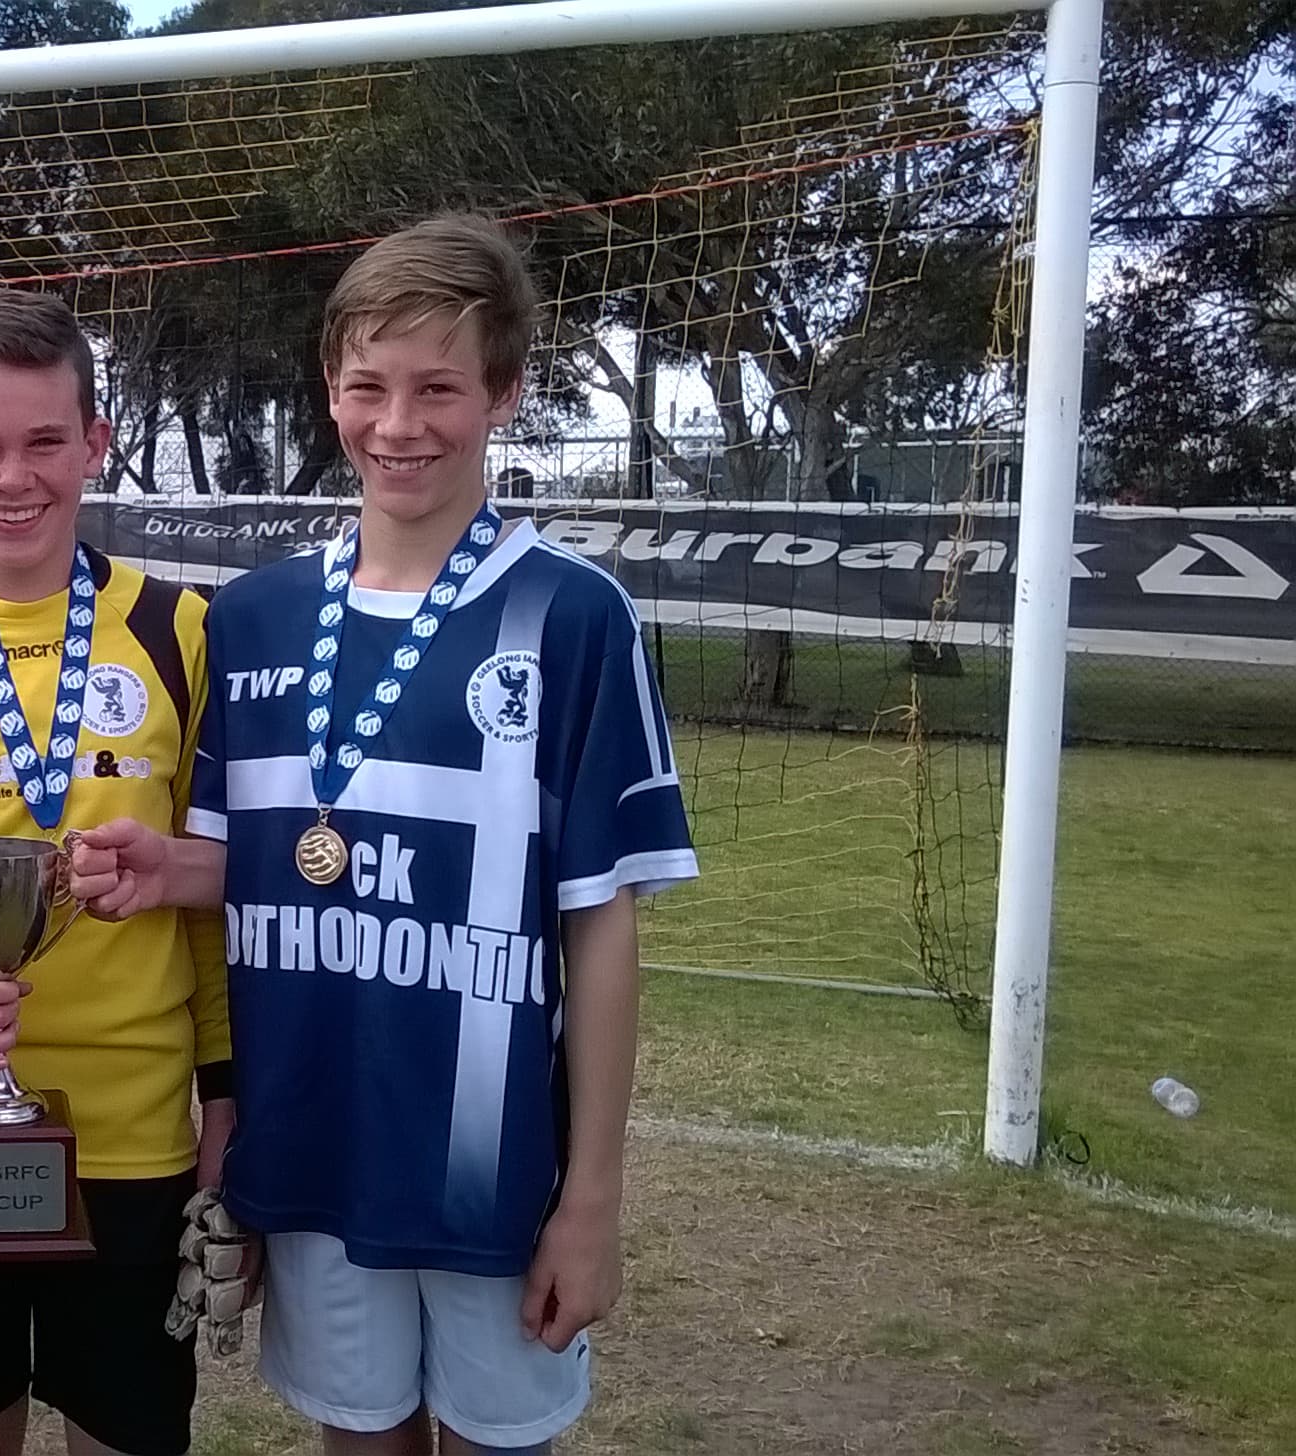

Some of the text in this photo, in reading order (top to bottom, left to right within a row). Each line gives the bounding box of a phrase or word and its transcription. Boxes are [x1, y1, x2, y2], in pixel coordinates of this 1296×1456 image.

[107, 666, 141, 688] RANGERS
[477, 655, 521, 679] GEELONG
[226, 666, 305, 702] TWP
[108, 721, 137, 734] SPORTS
[134, 703, 146, 722] CLUB
[471, 695, 494, 734] SOCCER
